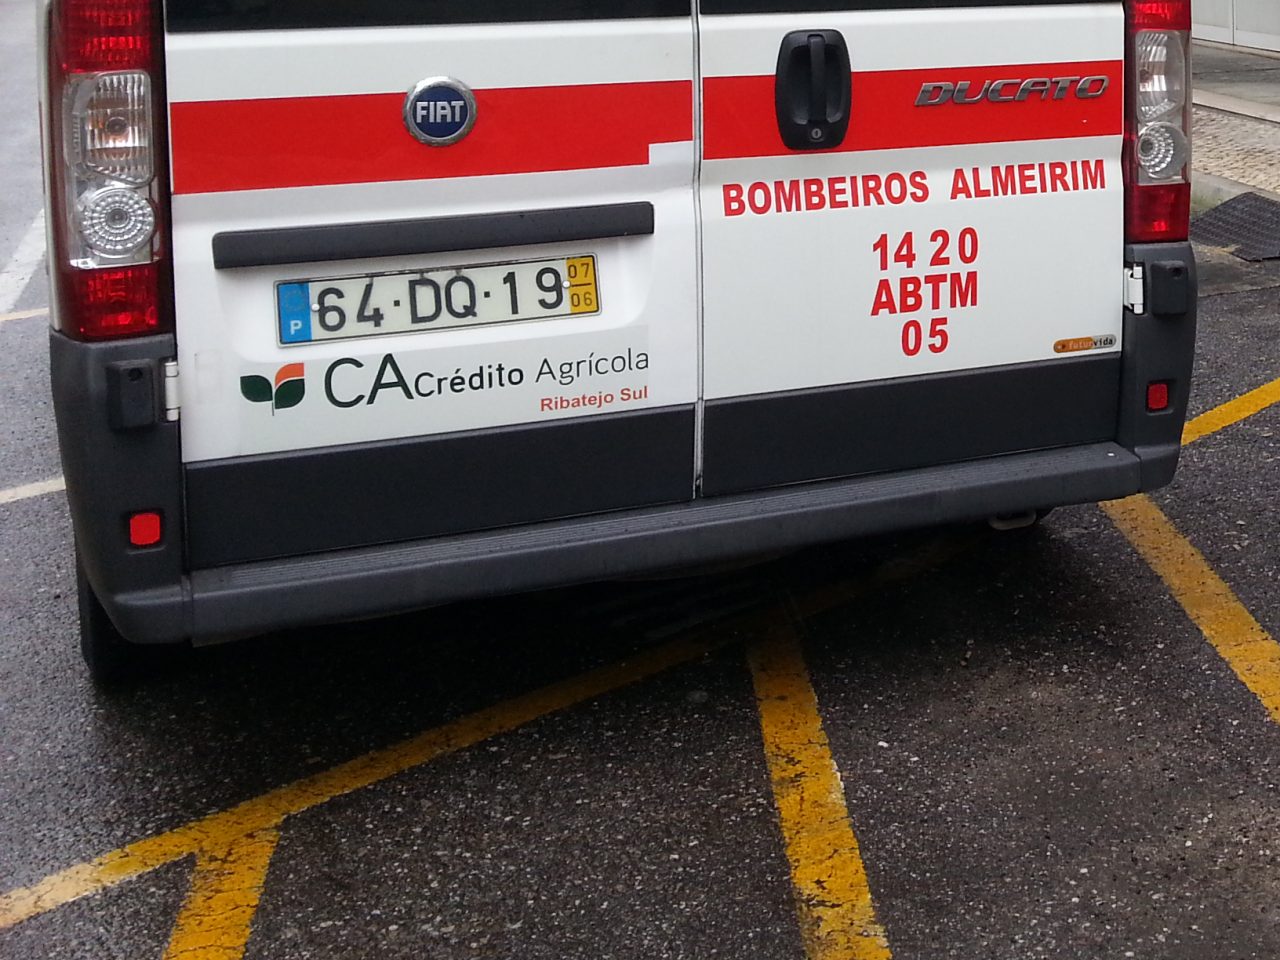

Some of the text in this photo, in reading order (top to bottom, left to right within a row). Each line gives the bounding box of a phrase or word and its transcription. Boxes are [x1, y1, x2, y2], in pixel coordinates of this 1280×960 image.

[914, 75, 1109, 107] DUCATO
[415, 99, 465, 124] FIAT
[722, 159, 1106, 217] BOMBEIROS ALMEIRIM
[870, 271, 979, 316] ABTM
[901, 317, 950, 357] 05
[414, 364, 524, 397] Crédito
[534, 347, 650, 385] Agrícola
[540, 385, 649, 412] Ribatejo Sul
